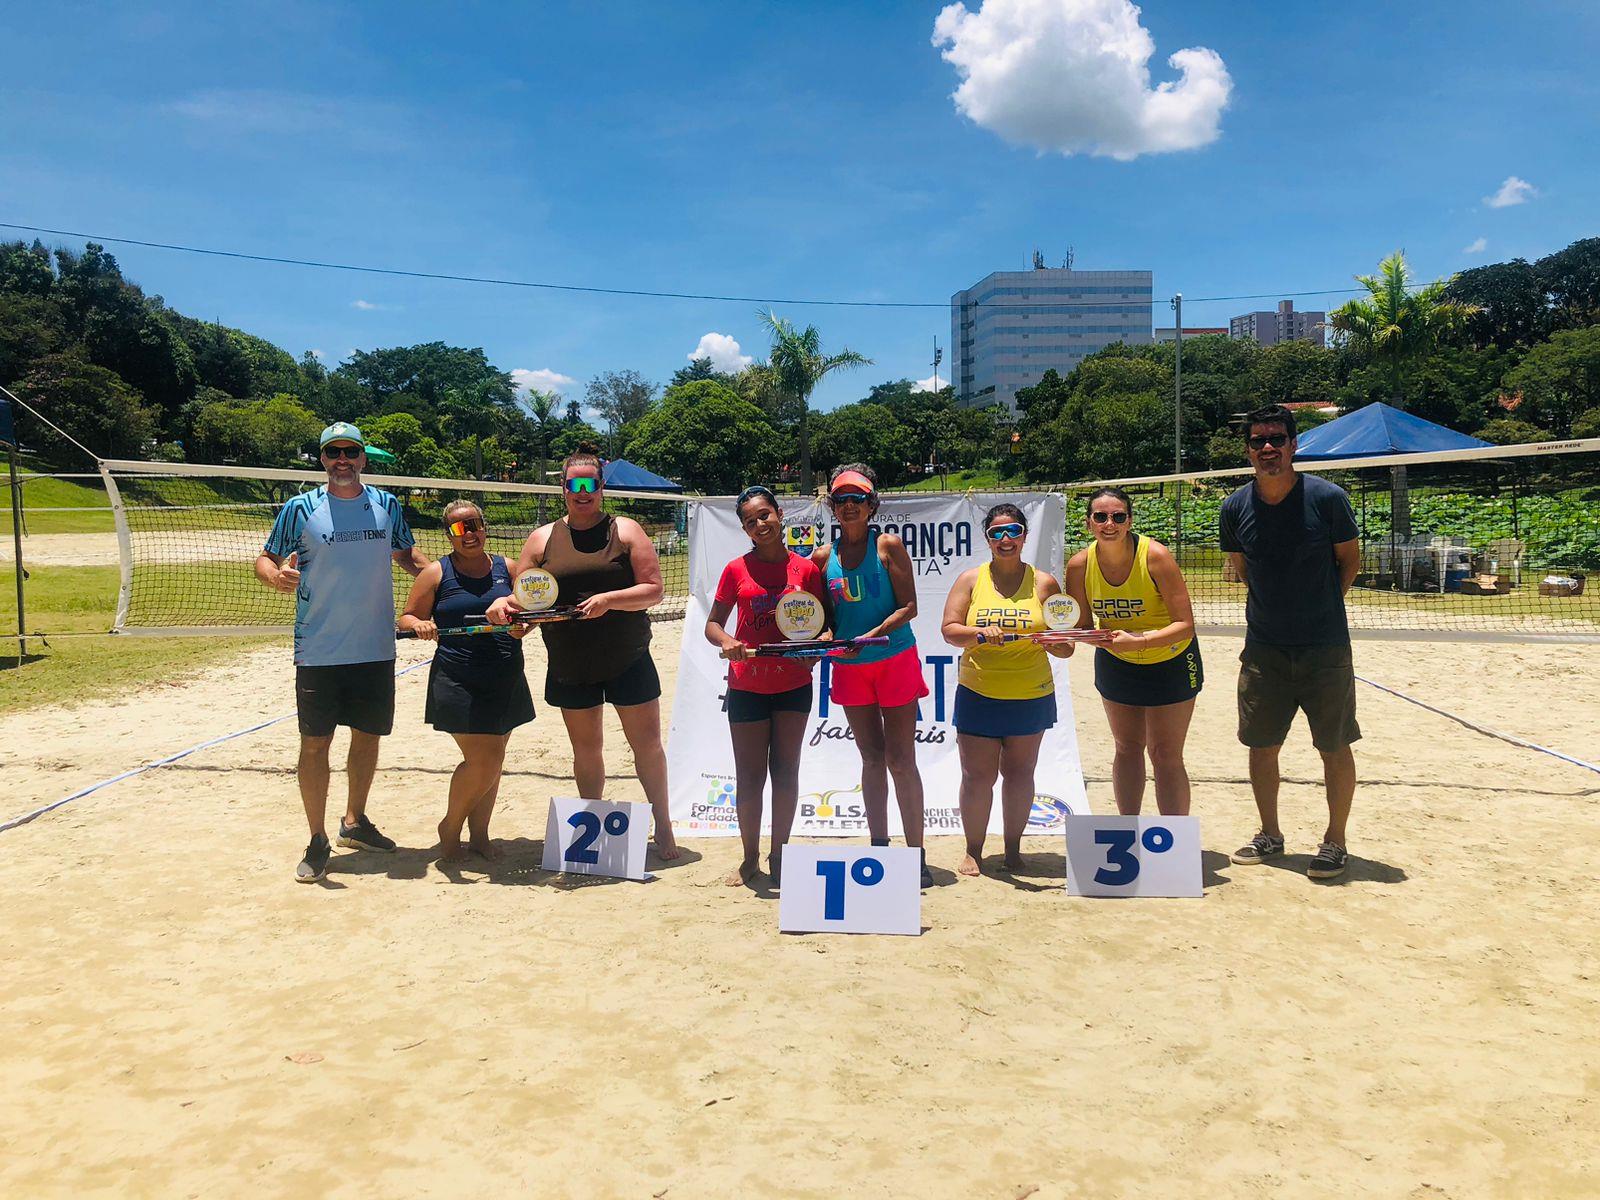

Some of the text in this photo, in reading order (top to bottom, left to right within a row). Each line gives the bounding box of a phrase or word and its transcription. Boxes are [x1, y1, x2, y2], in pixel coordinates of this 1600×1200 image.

[897, 513, 911, 523] DE
[363, 528, 387, 541] TENNIS
[1092, 598, 1143, 610] DROP
[976, 608, 1031, 618] DROP
[1186, 652, 1198, 689] BRAVO
